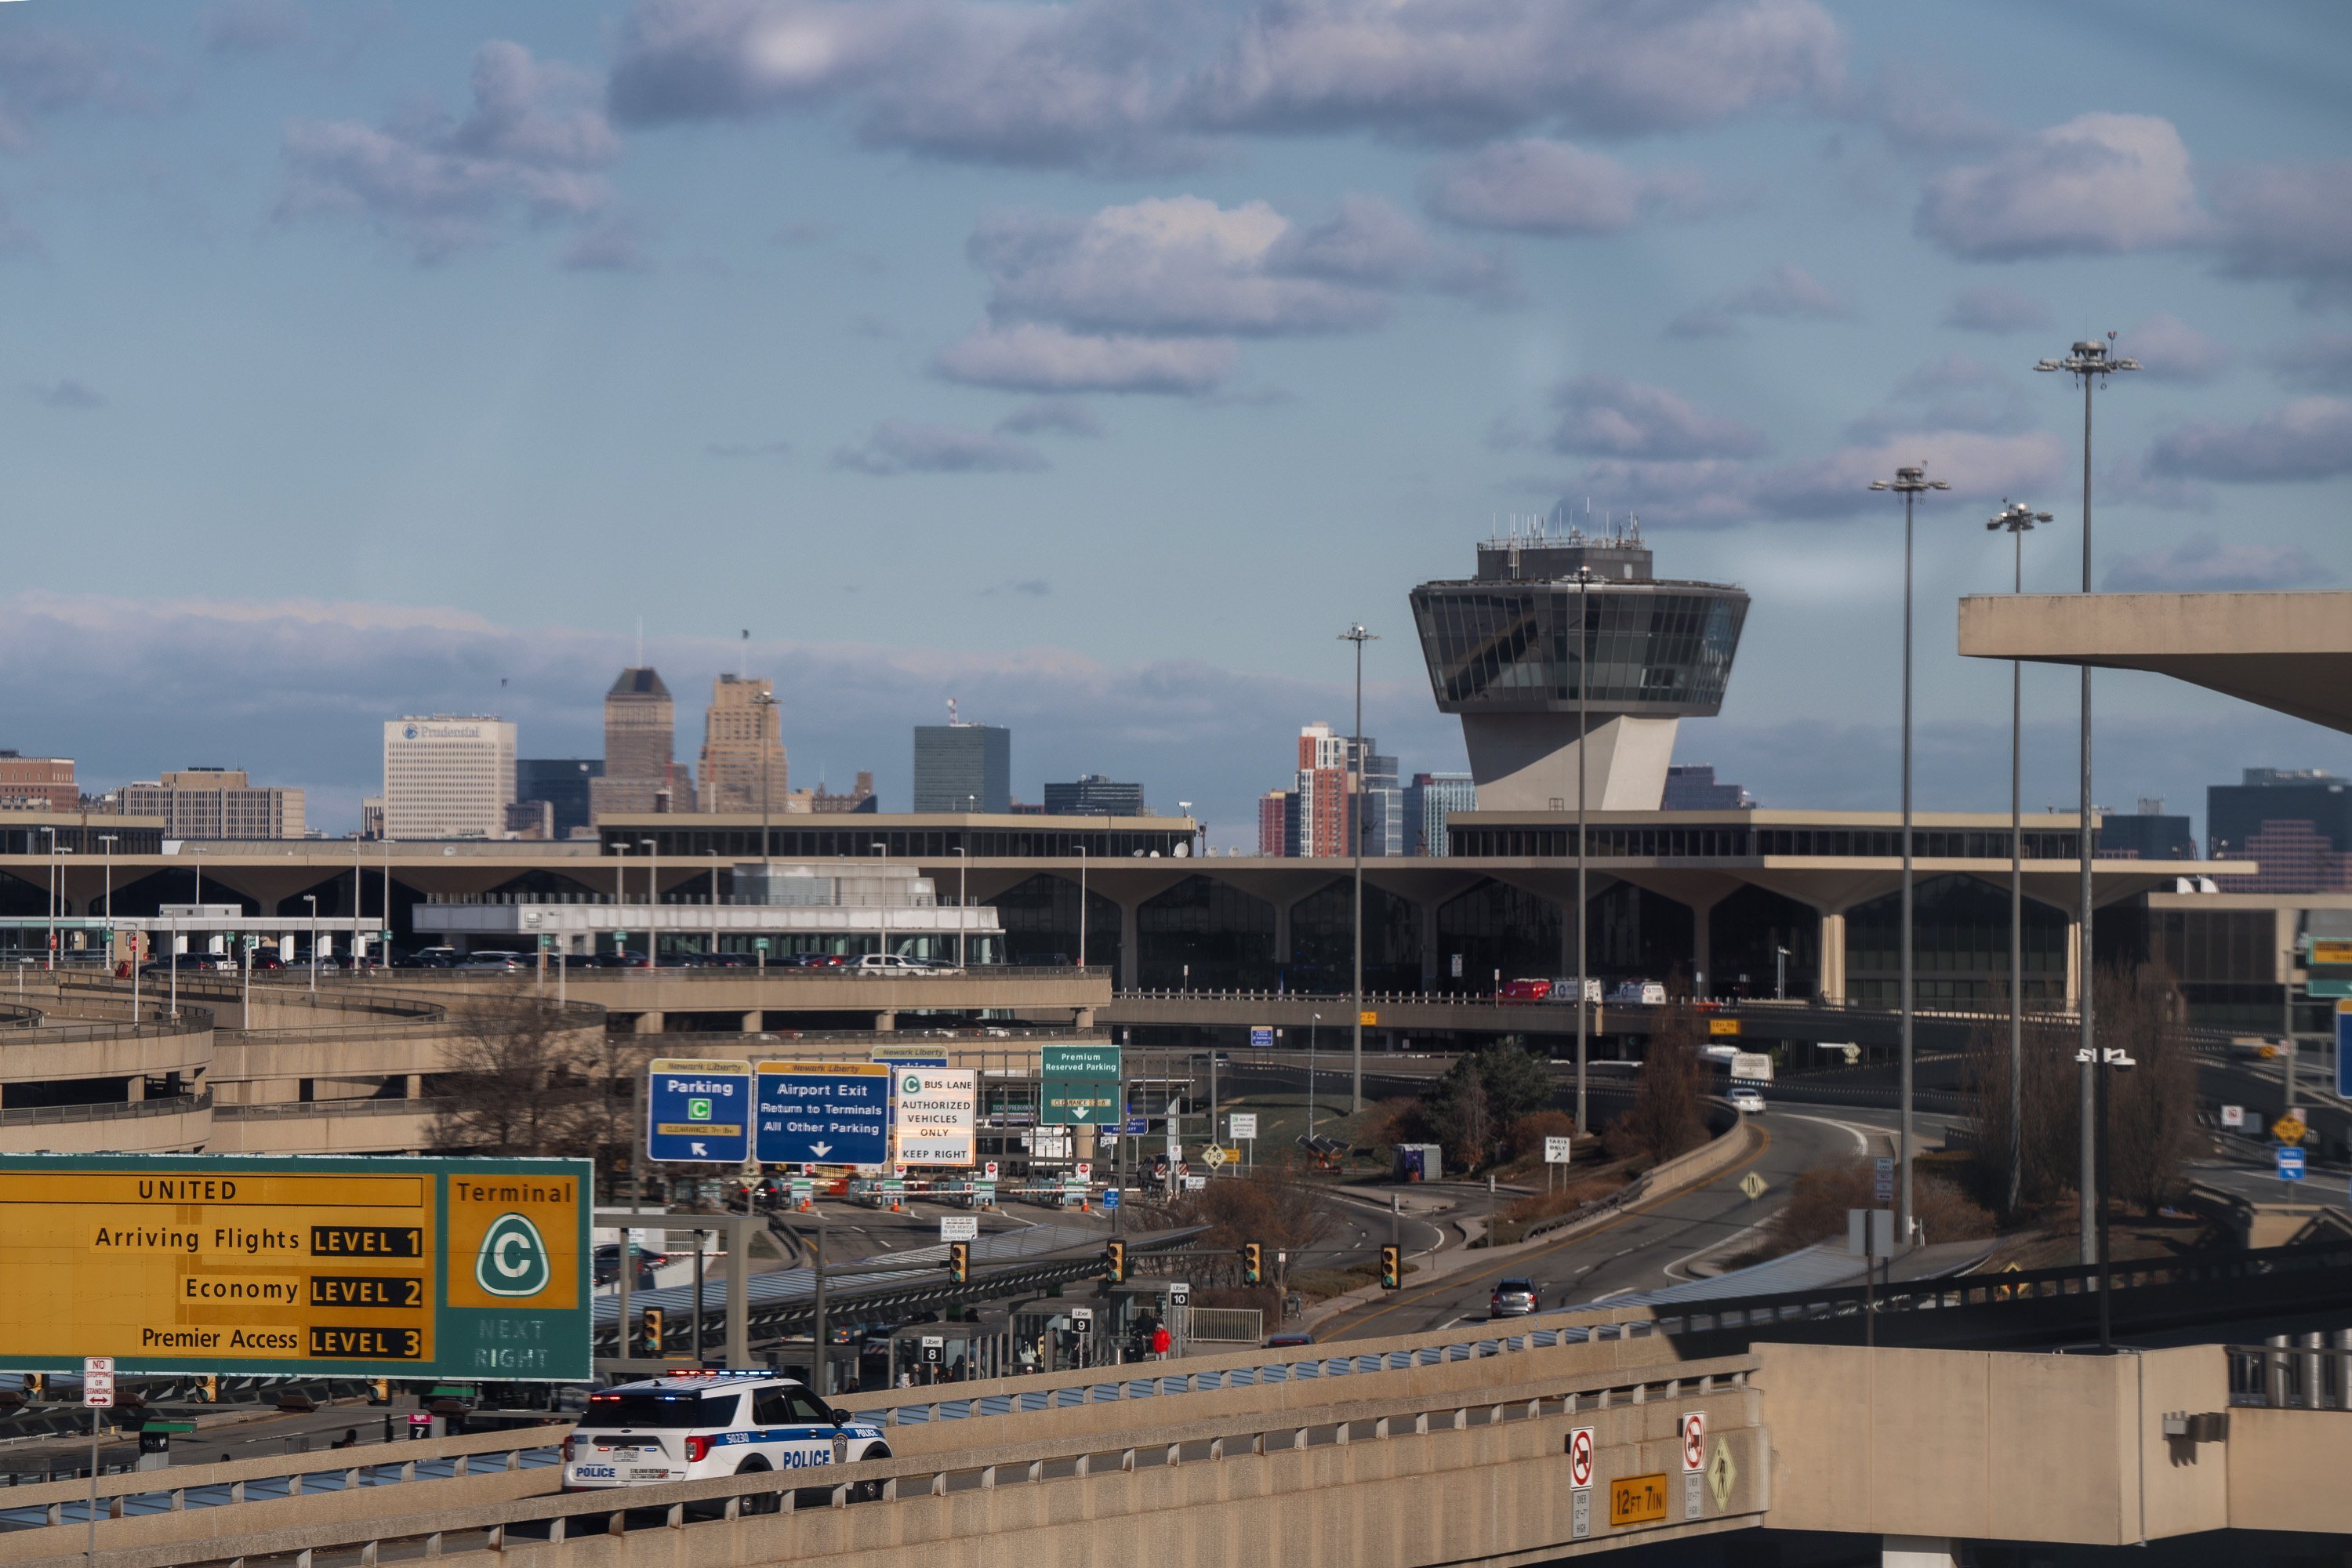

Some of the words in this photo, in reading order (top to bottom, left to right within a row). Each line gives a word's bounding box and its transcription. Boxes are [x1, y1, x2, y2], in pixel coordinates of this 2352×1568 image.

[420, 726, 479, 738] Prudential
[828, 1065, 860, 1074] Liberty
[1086, 1064, 1116, 1073] Parking
[667, 1080, 734, 1097] Parking
[777, 1083, 831, 1098] Airport
[837, 1085, 868, 1096] Exit
[906, 1077, 918, 1092] C
[924, 1080, 942, 1089] BUS
[692, 1102, 707, 1116] C
[760, 1102, 803, 1113] Return
[807, 1104, 820, 1114] to
[826, 1105, 882, 1116] Terminals
[902, 1101, 971, 1109] AUTHORIZED
[763, 1121, 782, 1131] All
[786, 1122, 824, 1132] Other
[829, 1123, 879, 1135] Parking
[920, 1128, 949, 1137] ONLY
[902, 1149, 929, 1158] KEEP
[935, 1150, 967, 1159] RIGHT
[139, 1180, 236, 1200] UNITED
[456, 1182, 571, 1203] Terminal
[95, 1226, 199, 1253] Arriving
[215, 1227, 299, 1254] Flights
[315, 1232, 392, 1252] LEVEL
[406, 1229, 420, 1254] 1
[494, 1232, 532, 1278] C
[187, 1278, 298, 1304] Economy
[312, 1281, 390, 1302] LEVEL
[405, 1280, 421, 1305] 2
[1174, 1294, 1186, 1305] 10
[479, 1319, 546, 1339] NEXT
[1078, 1320, 1086, 1330] 9
[142, 1327, 220, 1348] Premier
[230, 1329, 298, 1348] Access
[311, 1331, 389, 1352] LEVEL
[404, 1330, 420, 1356] 3
[474, 1348, 549, 1367] RIGHT
[928, 1349, 937, 1359] 8
[93, 1360, 105, 1370] NO
[415, 1427, 426, 1439] 7
[855, 1428, 879, 1438] POLICE
[784, 1449, 831, 1469] POLICE
[576, 1467, 615, 1478] POLICE
